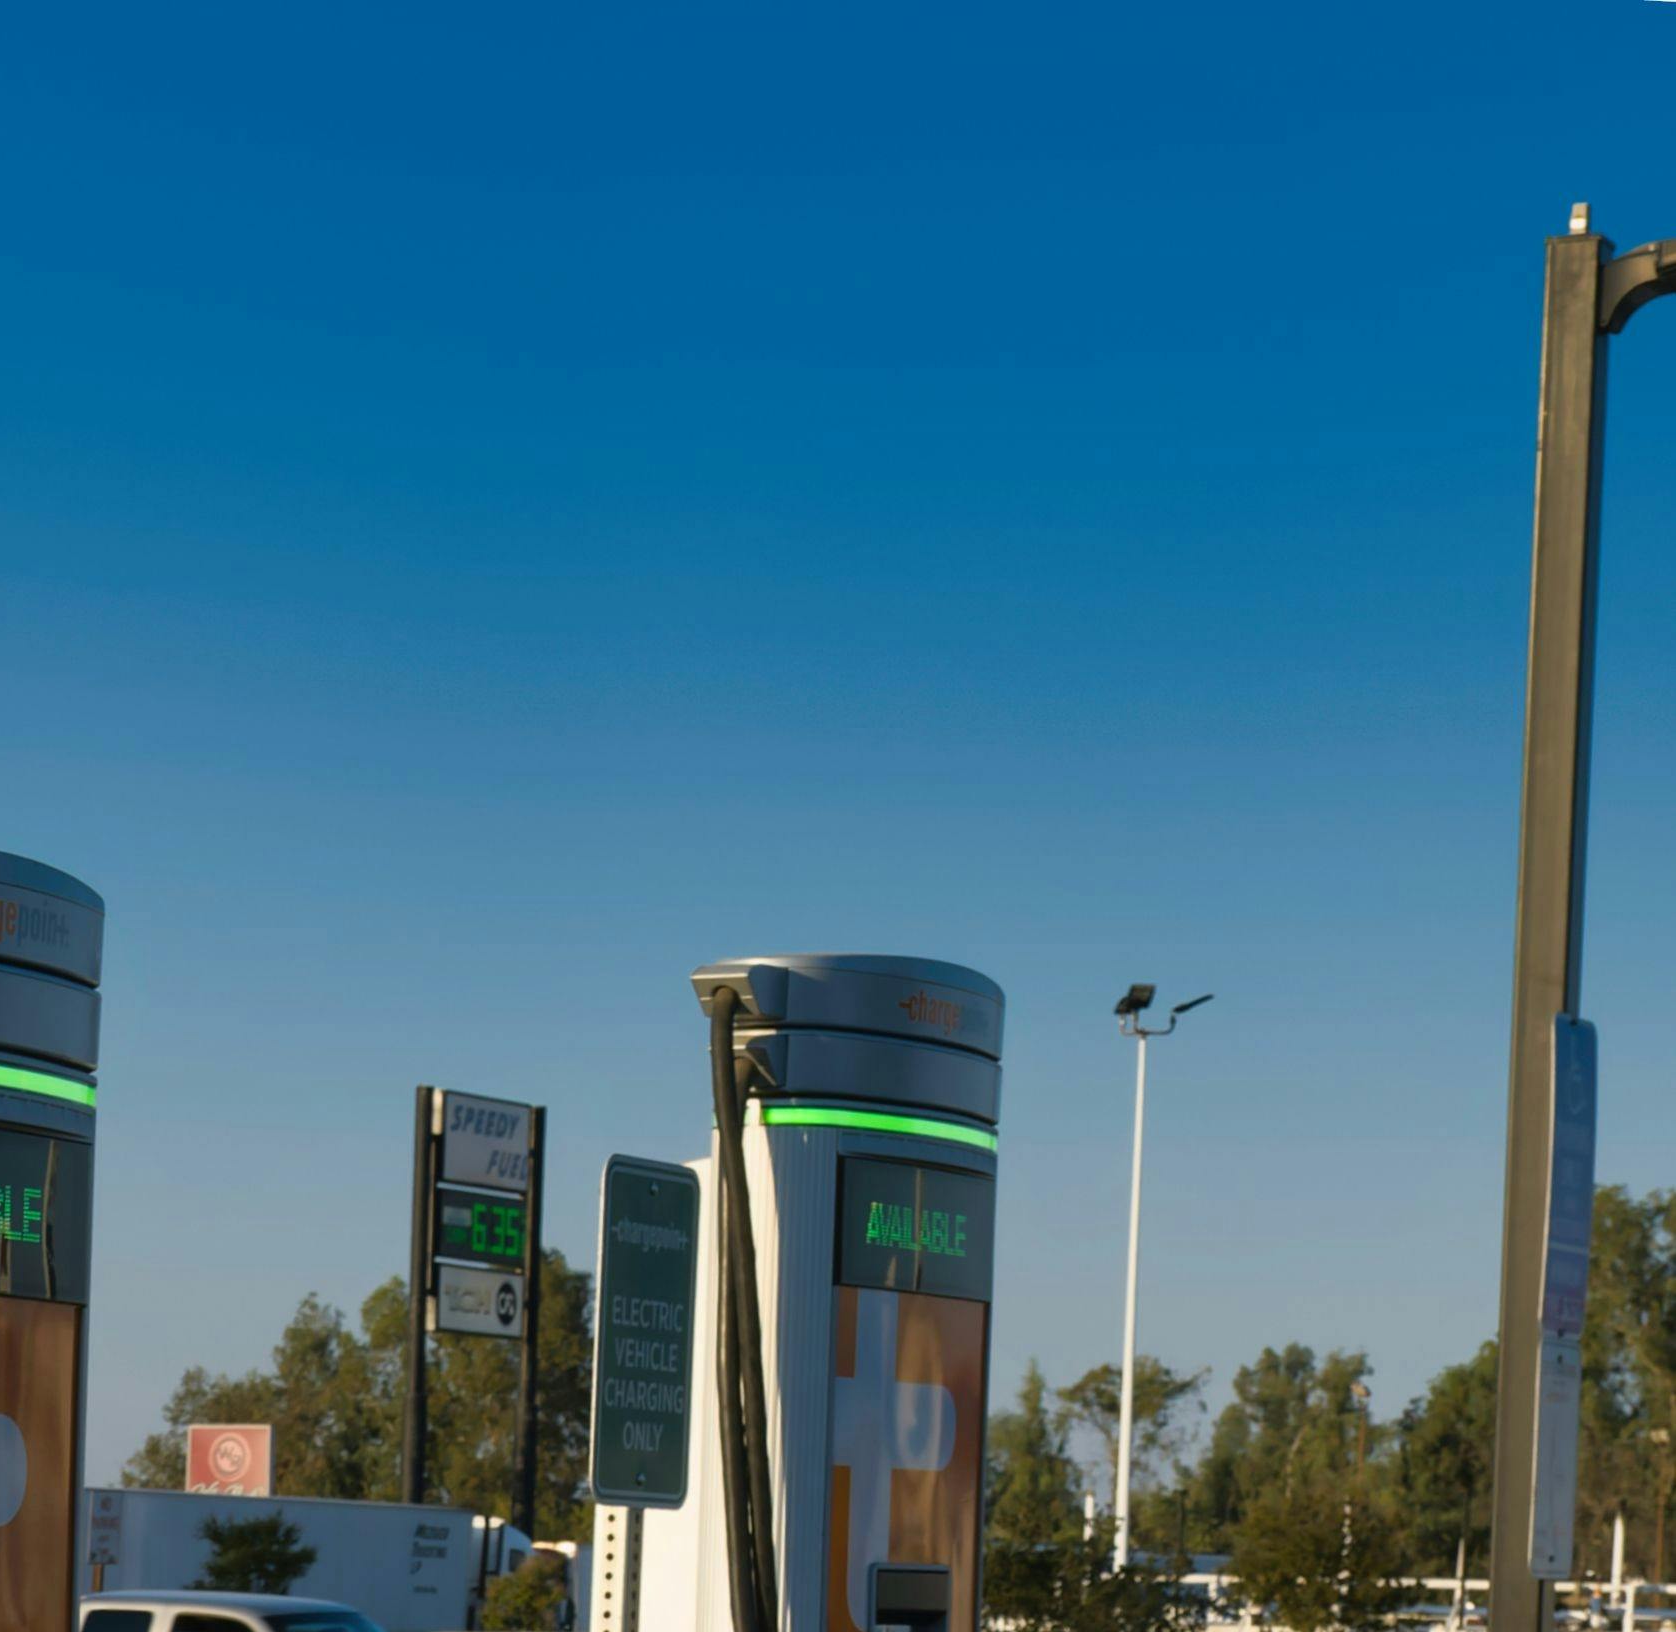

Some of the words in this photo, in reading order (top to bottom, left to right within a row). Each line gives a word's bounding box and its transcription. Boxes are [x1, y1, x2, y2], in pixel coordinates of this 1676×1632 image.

[450, 1104, 520, 1140] SPEEDY
[866, 1201, 967, 1256] AVAILABLE
[611, 1295, 684, 1332] ELECTRIC
[614, 1337, 679, 1373] VEHICLE
[604, 1377, 684, 1414] CHARGING
[622, 1421, 664, 1451] ONLY
